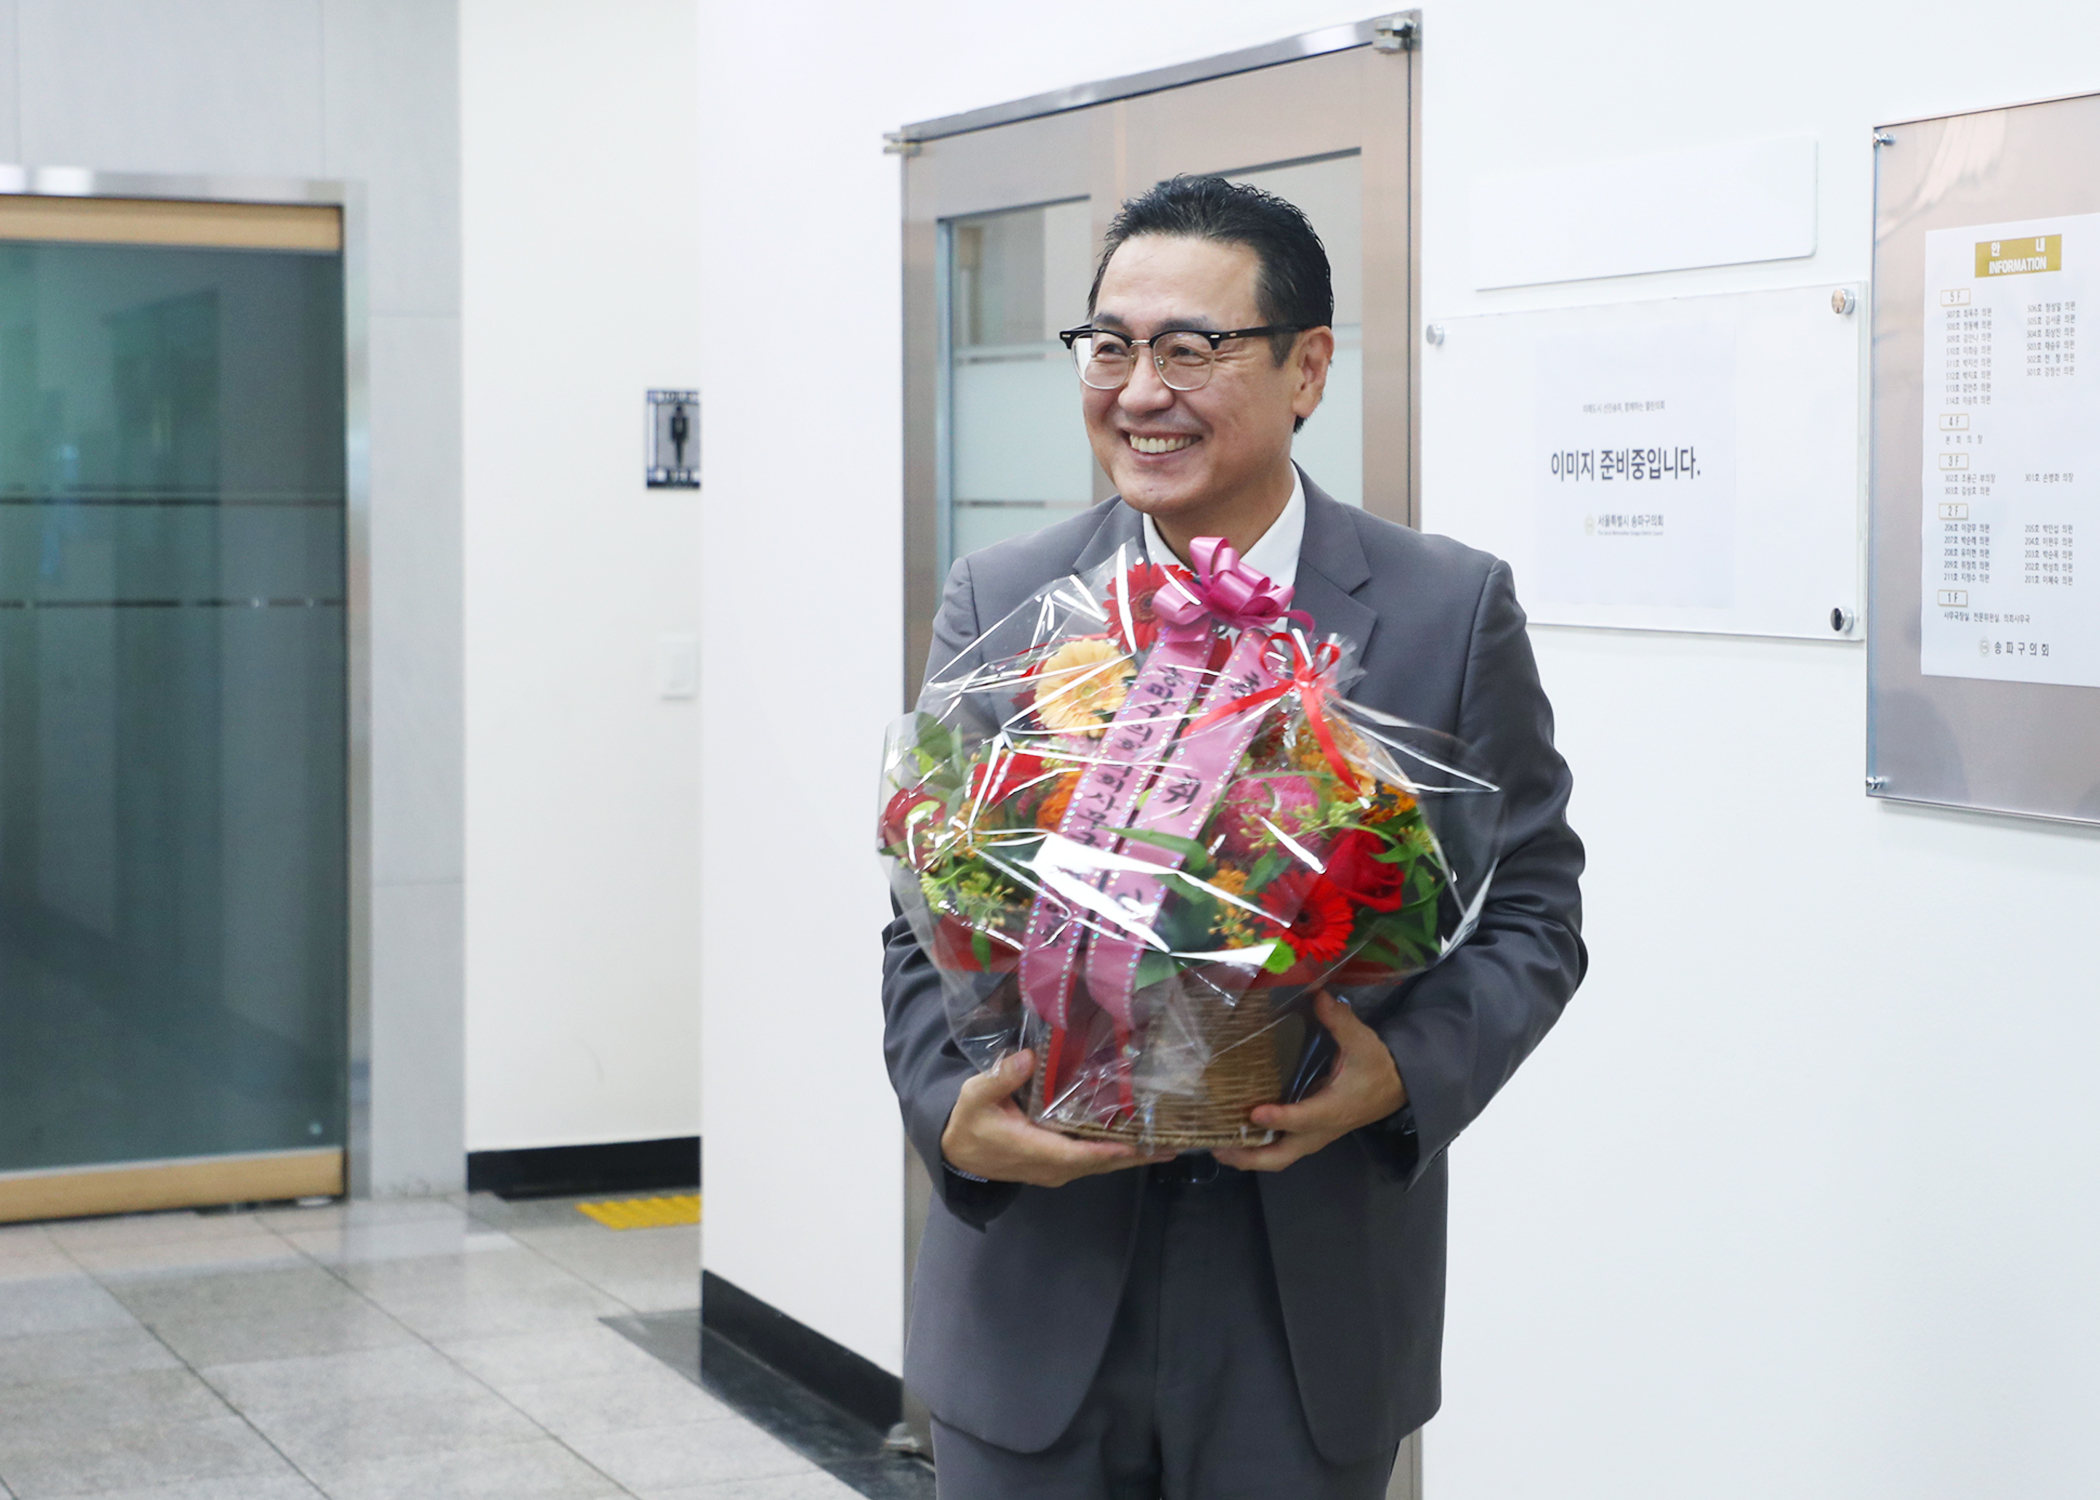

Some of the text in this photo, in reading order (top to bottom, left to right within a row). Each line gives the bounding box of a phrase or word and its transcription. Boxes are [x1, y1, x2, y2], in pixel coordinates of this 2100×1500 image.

[1989, 256, 2046, 274] INFORMATION
[2028, 304, 2042, 312] 506호
[2065, 301, 2076, 311] 의원
[1946, 310, 1960, 319] 507호
[1982, 308, 1992, 317] 의원
[2028, 316, 2042, 325] 505호
[2064, 314, 2075, 324] 의원
[1982, 320, 1992, 330] 의원
[1981, 332, 1992, 342] 의원
[2027, 329, 2042, 338] 504호
[2064, 327, 2075, 337] 의원
[1981, 345, 1991, 355] 의원
[2027, 342, 2042, 351] 503호
[2064, 340, 2075, 350] 의원
[1946, 359, 1960, 368] 511호
[1981, 357, 1991, 367] 의원
[2027, 354, 2042, 364] 502호
[2064, 353, 2074, 362] 의원
[1946, 372, 1960, 380] 512호
[1981, 370, 1991, 380] 의원
[2027, 368, 2041, 376] 501호
[2064, 366, 2074, 376] 의원
[1981, 382, 1991, 392] 의원
[1980, 395, 1991, 405] 의원
[1551, 446, 1700, 482] 이미지 준비중입니다.
[1945, 474, 1958, 482] 302호
[1980, 474, 1996, 484] 부의장
[2025, 473, 2040, 482] 301호
[2063, 473, 2074, 482] 의장
[1945, 486, 1958, 494] 303호
[1980, 486, 1990, 496] 의원
[1598, 514, 1664, 528] 서울특별시 송파구의회
[1944, 524, 1958, 532] 206호
[1980, 524, 1990, 534] 의원
[2025, 524, 2040, 532] 205호
[2062, 524, 2073, 534] 의원
[1944, 536, 1958, 544] 207호
[1979, 536, 1990, 546] 의원
[2025, 537, 2040, 545] 204호
[2062, 537, 2073, 547] 의원
[1944, 548, 1958, 556] 208호
[1980, 548, 1990, 558] 의원
[2025, 550, 2040, 558] 203호
[2062, 550, 2073, 560] 의원
[1944, 560, 1958, 569] 209호
[1979, 561, 1990, 571] 의원
[2025, 562, 2040, 571] 202호
[2062, 563, 2073, 573] 의원
[1944, 573, 1958, 581] 211호
[1979, 574, 1990, 583] 의원
[2025, 575, 2039, 584] 201호
[2062, 576, 2073, 586] 의원
[1995, 641, 2049, 657] 송파구의회
[1163, 773, 1202, 815] 취
